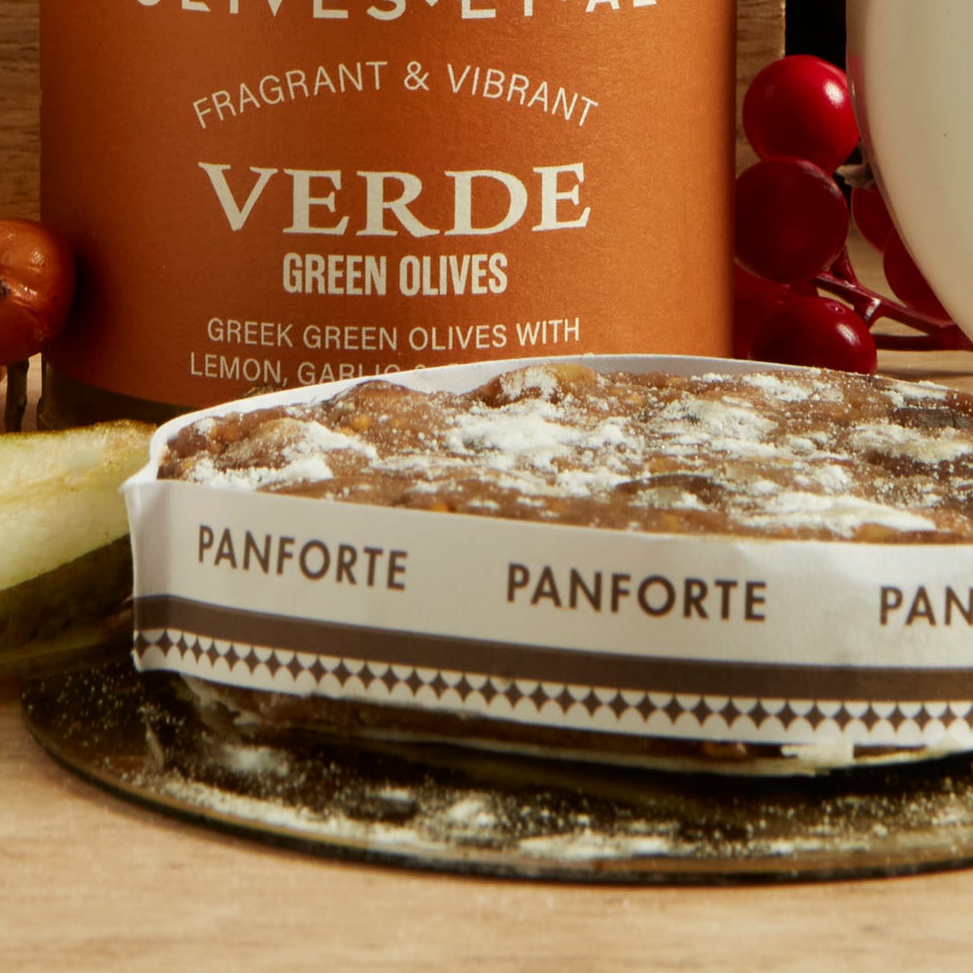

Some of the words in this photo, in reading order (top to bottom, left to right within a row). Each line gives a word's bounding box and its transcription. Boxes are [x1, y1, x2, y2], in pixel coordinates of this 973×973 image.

[192, 61, 388, 129] FRAGRANT
[403, 60, 430, 91] &
[447, 63, 599, 127] VIBRANT
[198, 161, 592, 238] VERDE
[282, 252, 387, 296] GREEN
[399, 252, 508, 296] OLIVES
[207, 317, 293, 347] GREEK
[303, 324, 397, 351] GREEN
[408, 323, 508, 351] OLIVES
[516, 317, 580, 346] WITH
[190, 352, 288, 387] LEMON,
[198, 525, 408, 591] PANFORTE
[507, 563, 767, 622] PANFORTE
[879, 585, 973, 627] PAN
